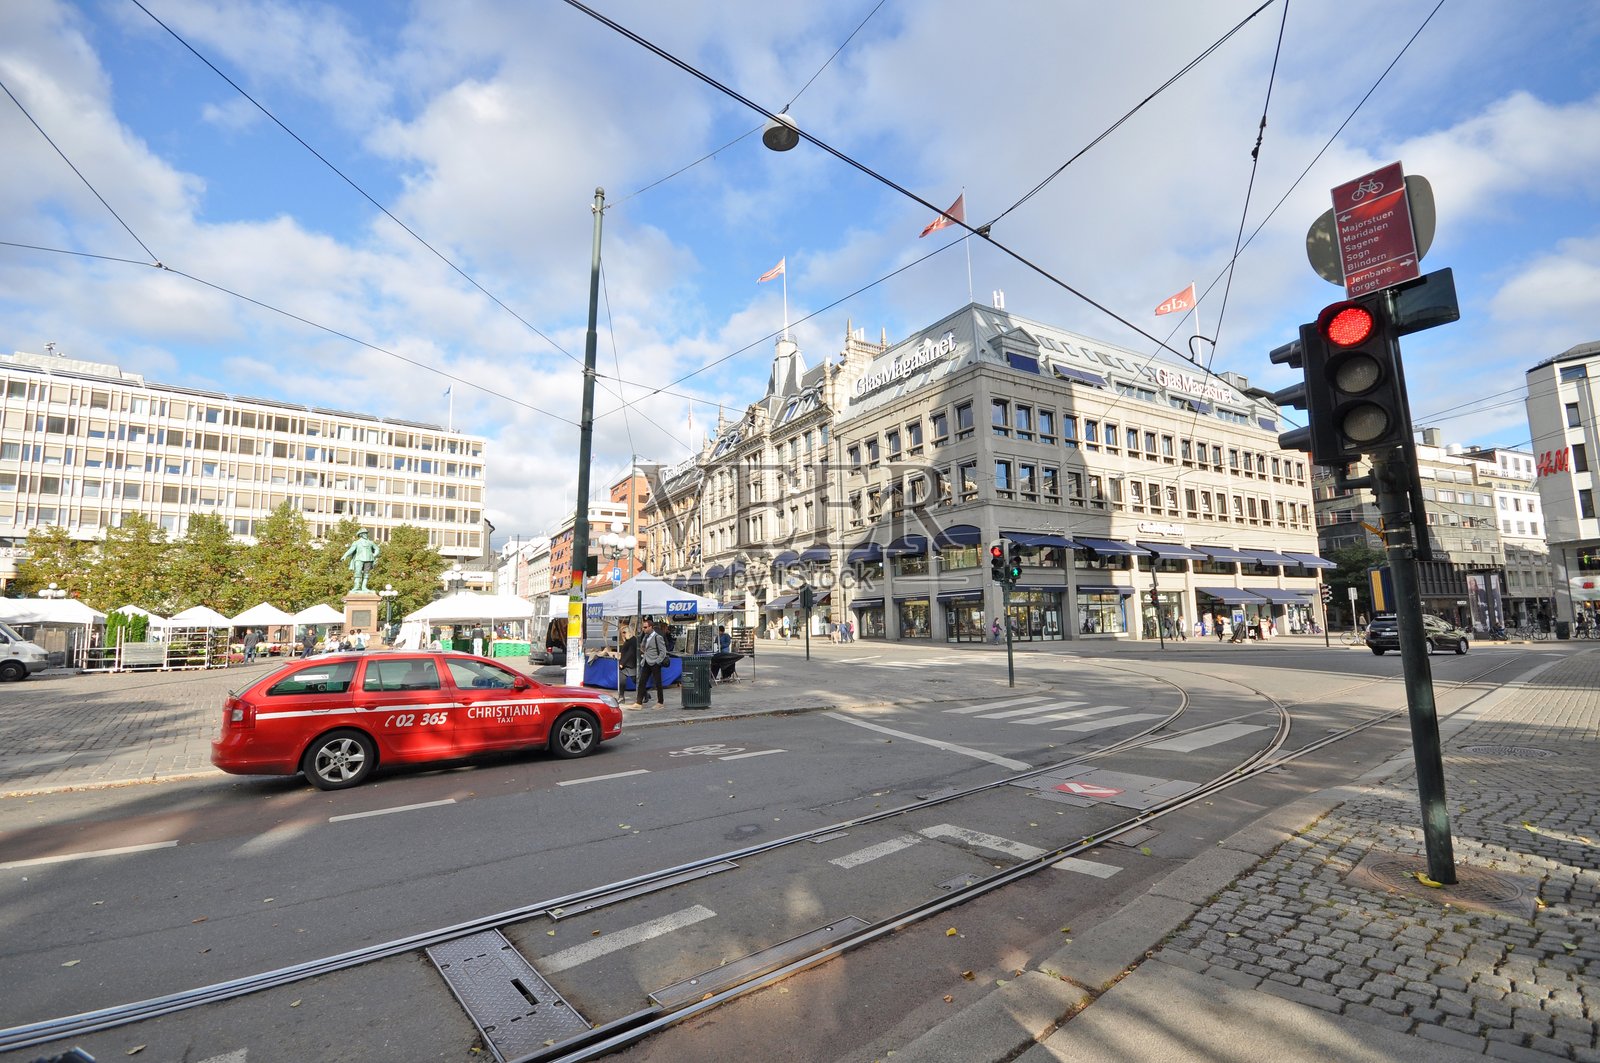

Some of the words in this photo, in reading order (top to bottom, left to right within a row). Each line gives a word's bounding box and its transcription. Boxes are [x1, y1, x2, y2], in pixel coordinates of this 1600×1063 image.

[1342, 210, 1394, 234] Majorstuen
[1343, 222, 1389, 243] Maridalen
[1345, 236, 1380, 254] Sagene
[1346, 249, 1370, 264] Sogn
[1347, 253, 1387, 271] Blindern
[1350, 265, 1396, 284] Jernbane-
[1351, 278, 1381, 293] torget
[856, 331, 958, 397] GlasMagasinet
[1156, 367, 1233, 404] GlasMagasinet
[668, 602, 696, 612] SØLV
[395, 713, 416, 728] 02
[419, 712, 449, 726] 365
[467, 704, 541, 719] CHRISTIANIA
[497, 716, 514, 724] TAXI
